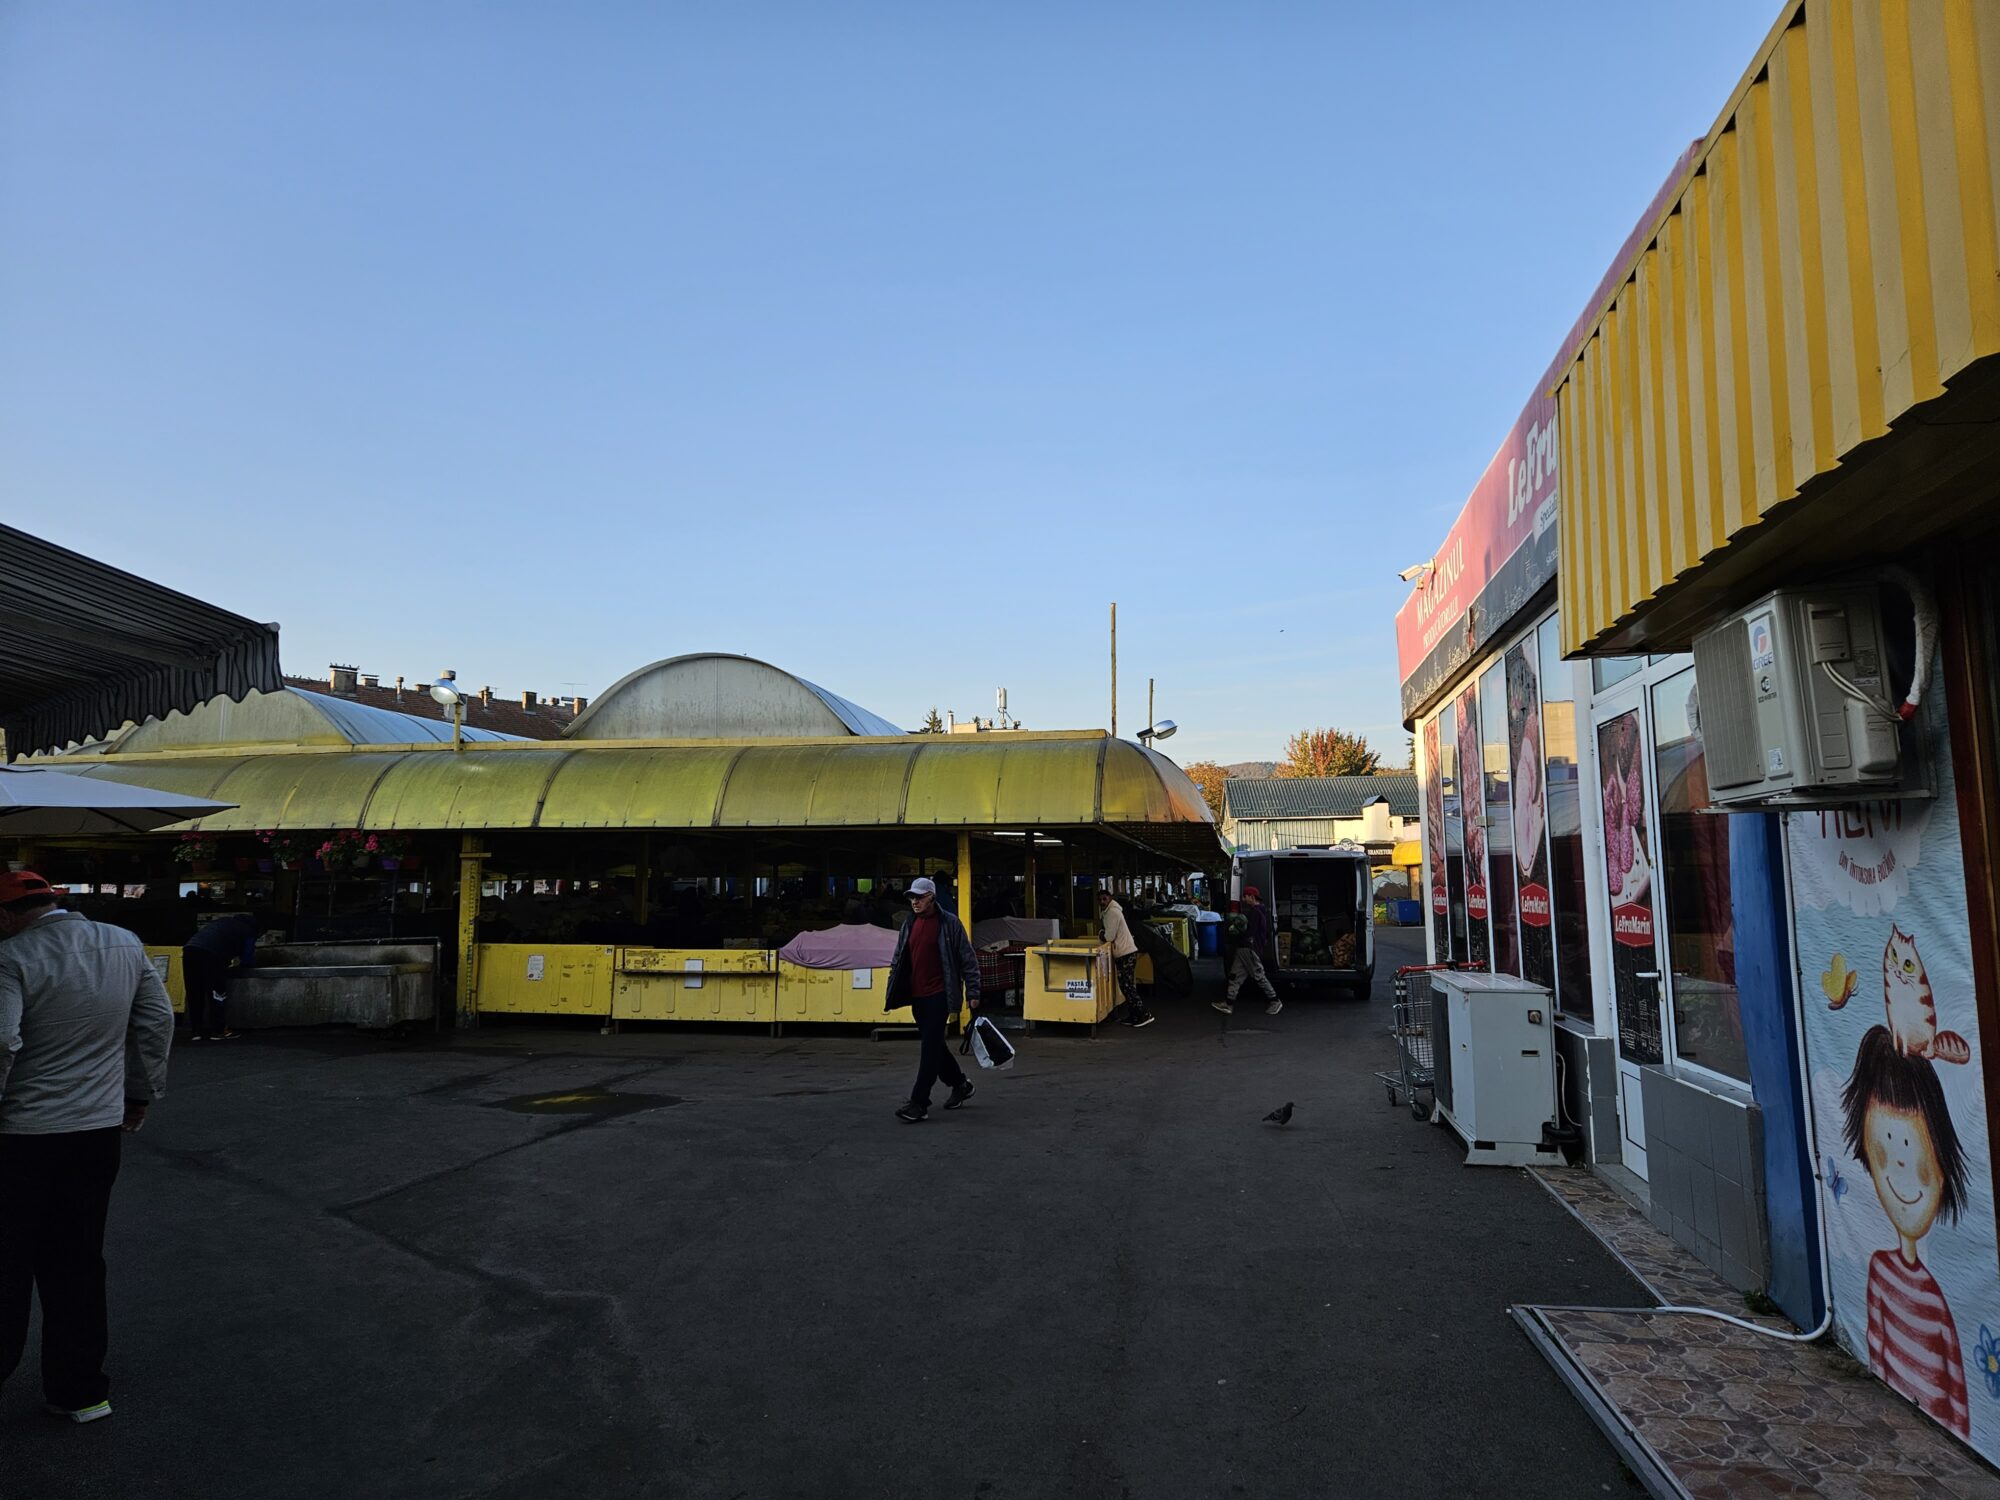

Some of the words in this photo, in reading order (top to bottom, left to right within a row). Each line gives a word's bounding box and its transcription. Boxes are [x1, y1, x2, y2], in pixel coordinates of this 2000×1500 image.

[1416, 536, 1465, 631] MAGAZINUL
[1753, 651, 1773, 670] GREE
[1521, 895, 1549, 915] LeFruMarin
[1615, 915, 1651, 936] LeFruMarin
